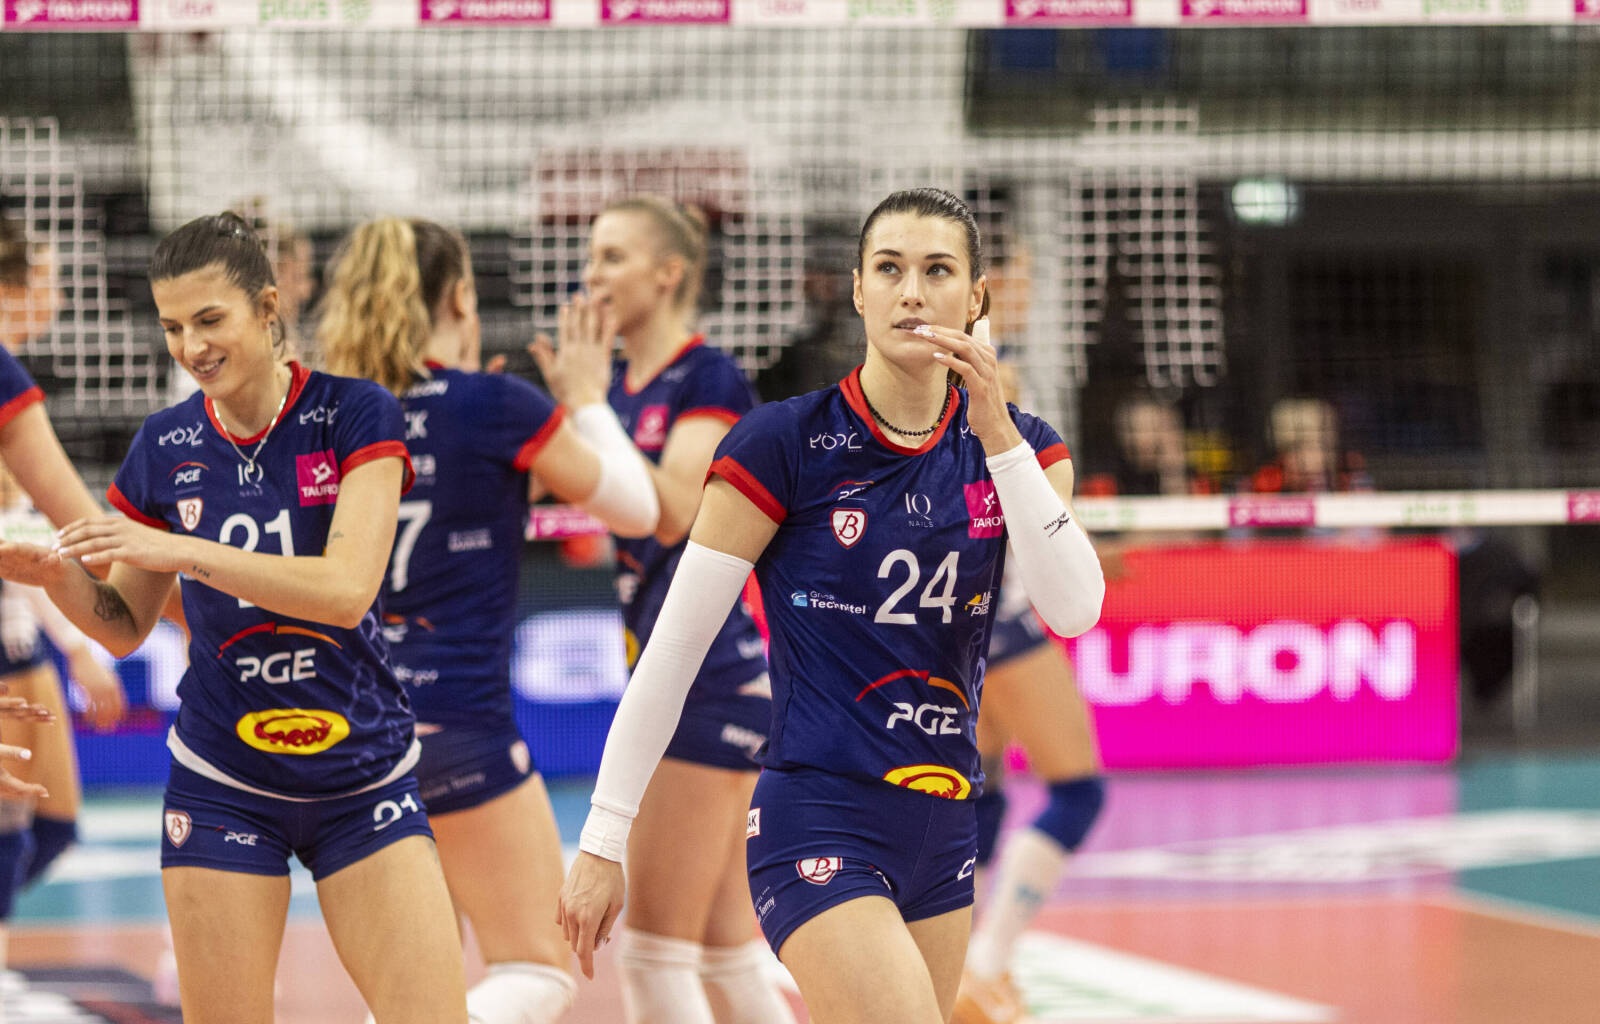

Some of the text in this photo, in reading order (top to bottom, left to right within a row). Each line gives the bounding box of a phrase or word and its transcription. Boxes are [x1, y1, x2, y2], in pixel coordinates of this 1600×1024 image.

[175, 468, 201, 485] PGE
[301, 483, 339, 498] TAURO
[905, 493, 933, 521] IQ
[908, 520, 934, 528] NAILS
[874, 549, 959, 624] 24
[810, 599, 867, 614] Technitel
[236, 648, 317, 685] PGE
[1077, 619, 1416, 706] URON
[886, 702, 961, 735] PGE
[224, 831, 258, 846] PGE
